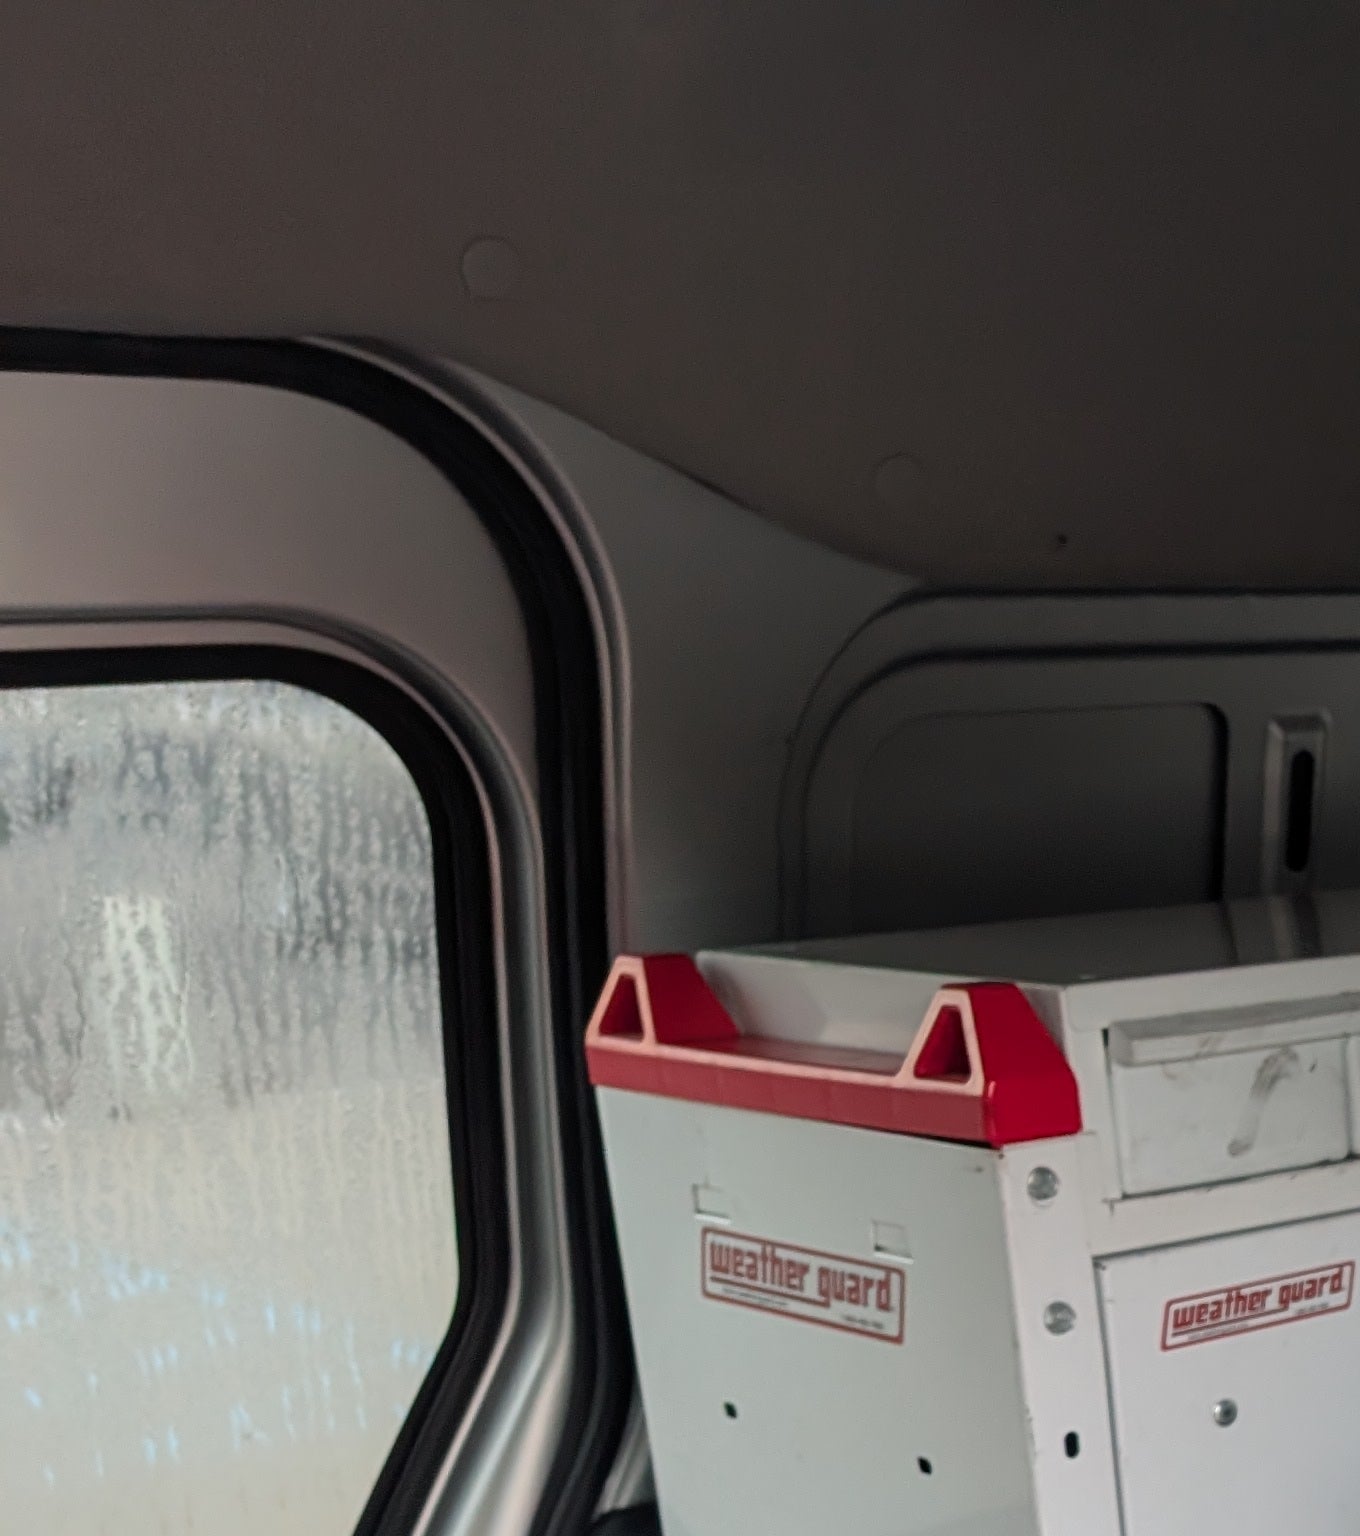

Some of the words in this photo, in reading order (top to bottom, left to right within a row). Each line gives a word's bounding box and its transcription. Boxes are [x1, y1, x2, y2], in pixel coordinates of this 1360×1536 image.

[710, 1241, 810, 1292] weather
[818, 1265, 893, 1312] guard
[1173, 1287, 1272, 1330] weather
[1278, 1264, 1345, 1311] guard
